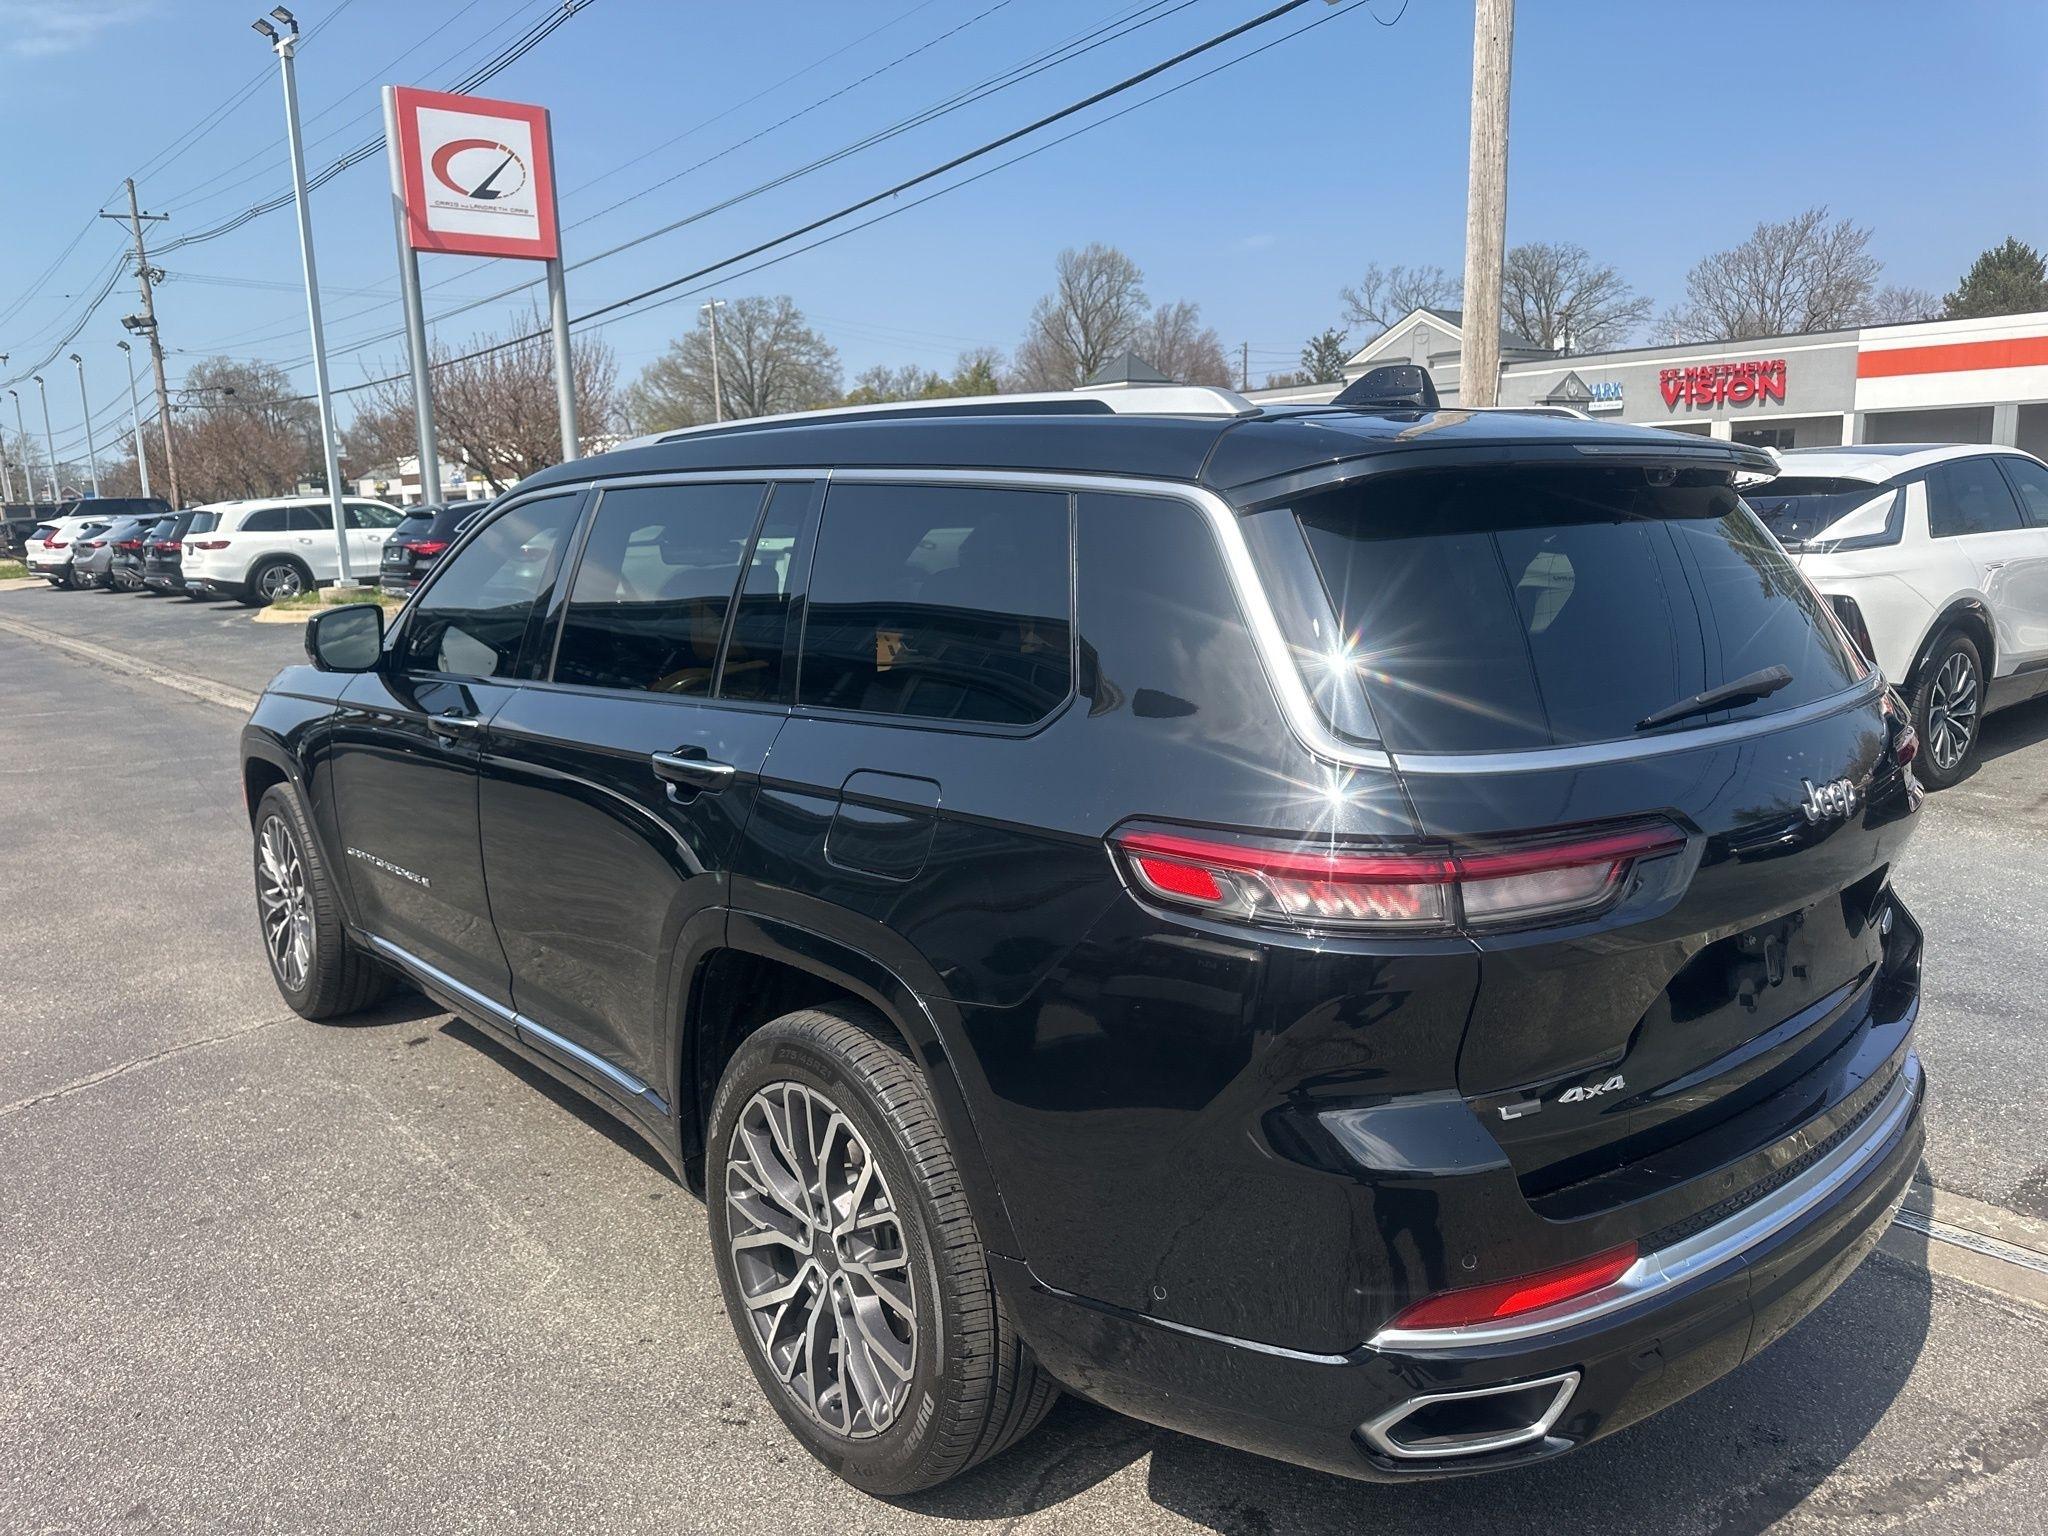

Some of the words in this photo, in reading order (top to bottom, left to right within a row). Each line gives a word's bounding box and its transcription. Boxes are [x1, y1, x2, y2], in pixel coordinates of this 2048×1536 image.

[1684, 359, 1786, 381] MATTHEWS
[1588, 382, 1622, 402] ARK
[1660, 374, 1786, 406] VISION
[1801, 778, 1857, 821] Jeep
[1558, 1075, 1625, 1102] 4x4
[892, 1391, 935, 1461] Dynap
